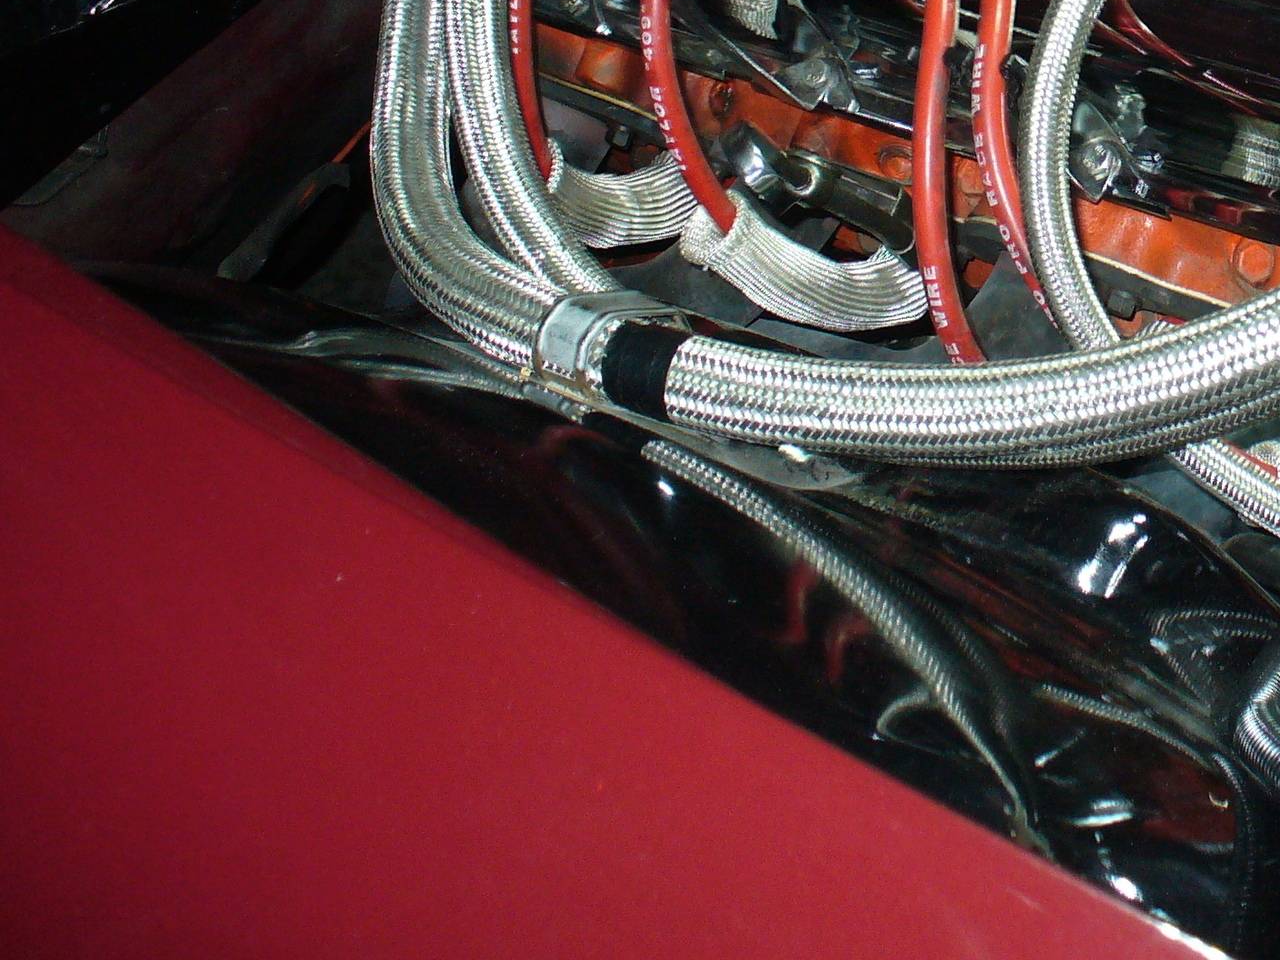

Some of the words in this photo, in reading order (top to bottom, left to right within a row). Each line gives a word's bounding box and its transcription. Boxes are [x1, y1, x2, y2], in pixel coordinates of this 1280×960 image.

[970, 42, 987, 116] WIRE
[973, 133, 1000, 208] RACE
[999, 223, 1028, 275] PRO
[923, 265, 949, 330] WIRE
